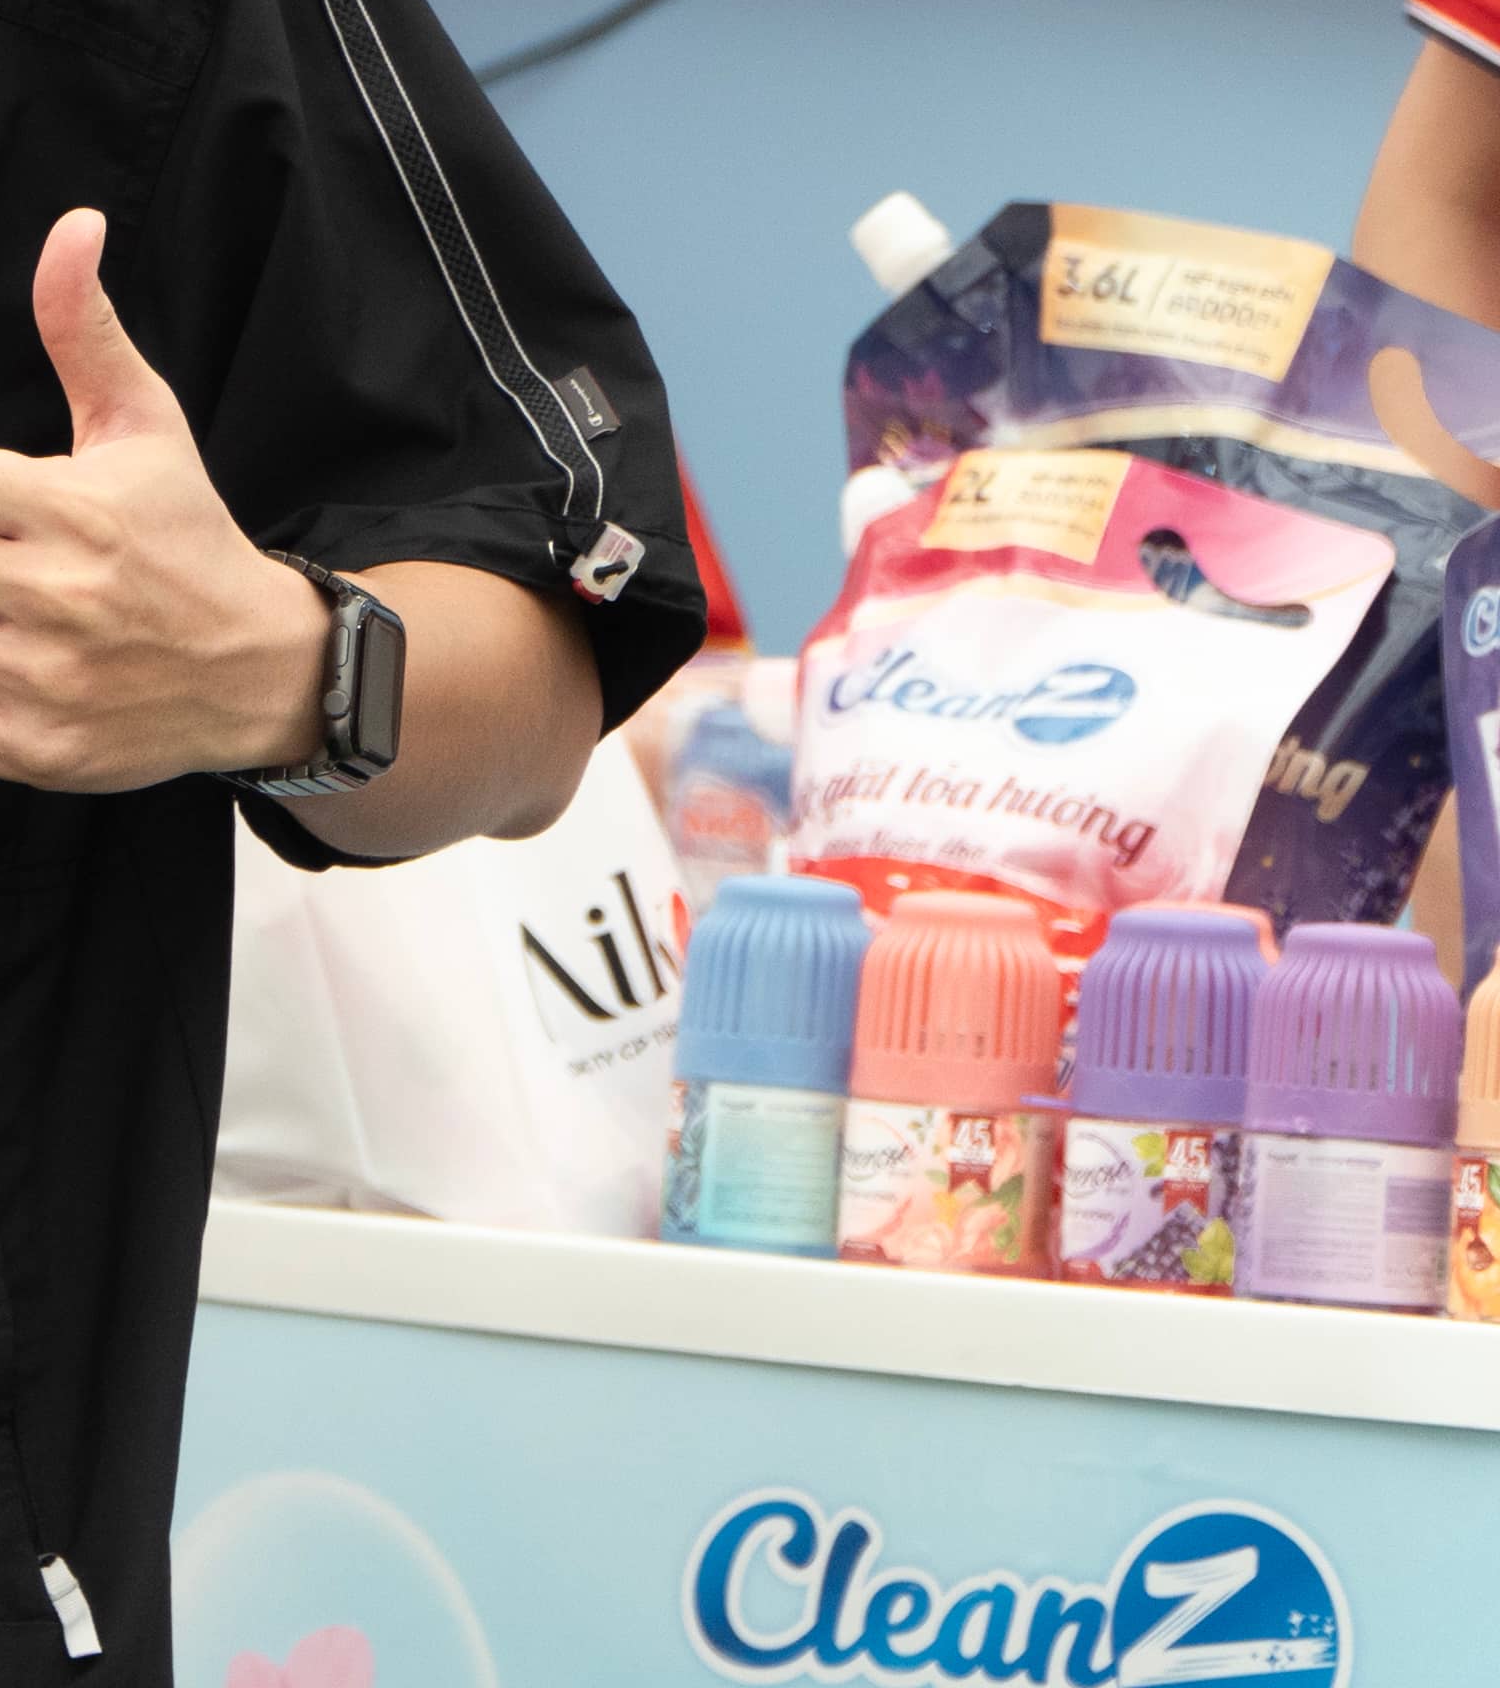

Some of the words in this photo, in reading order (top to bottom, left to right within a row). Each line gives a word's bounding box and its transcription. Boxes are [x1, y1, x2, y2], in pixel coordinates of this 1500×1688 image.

[828, 649, 1138, 743] CleanZ
[988, 775, 1159, 869] hương
[1170, 1135, 1206, 1163] 45
[695, 1500, 1338, 1688] CleanZ
